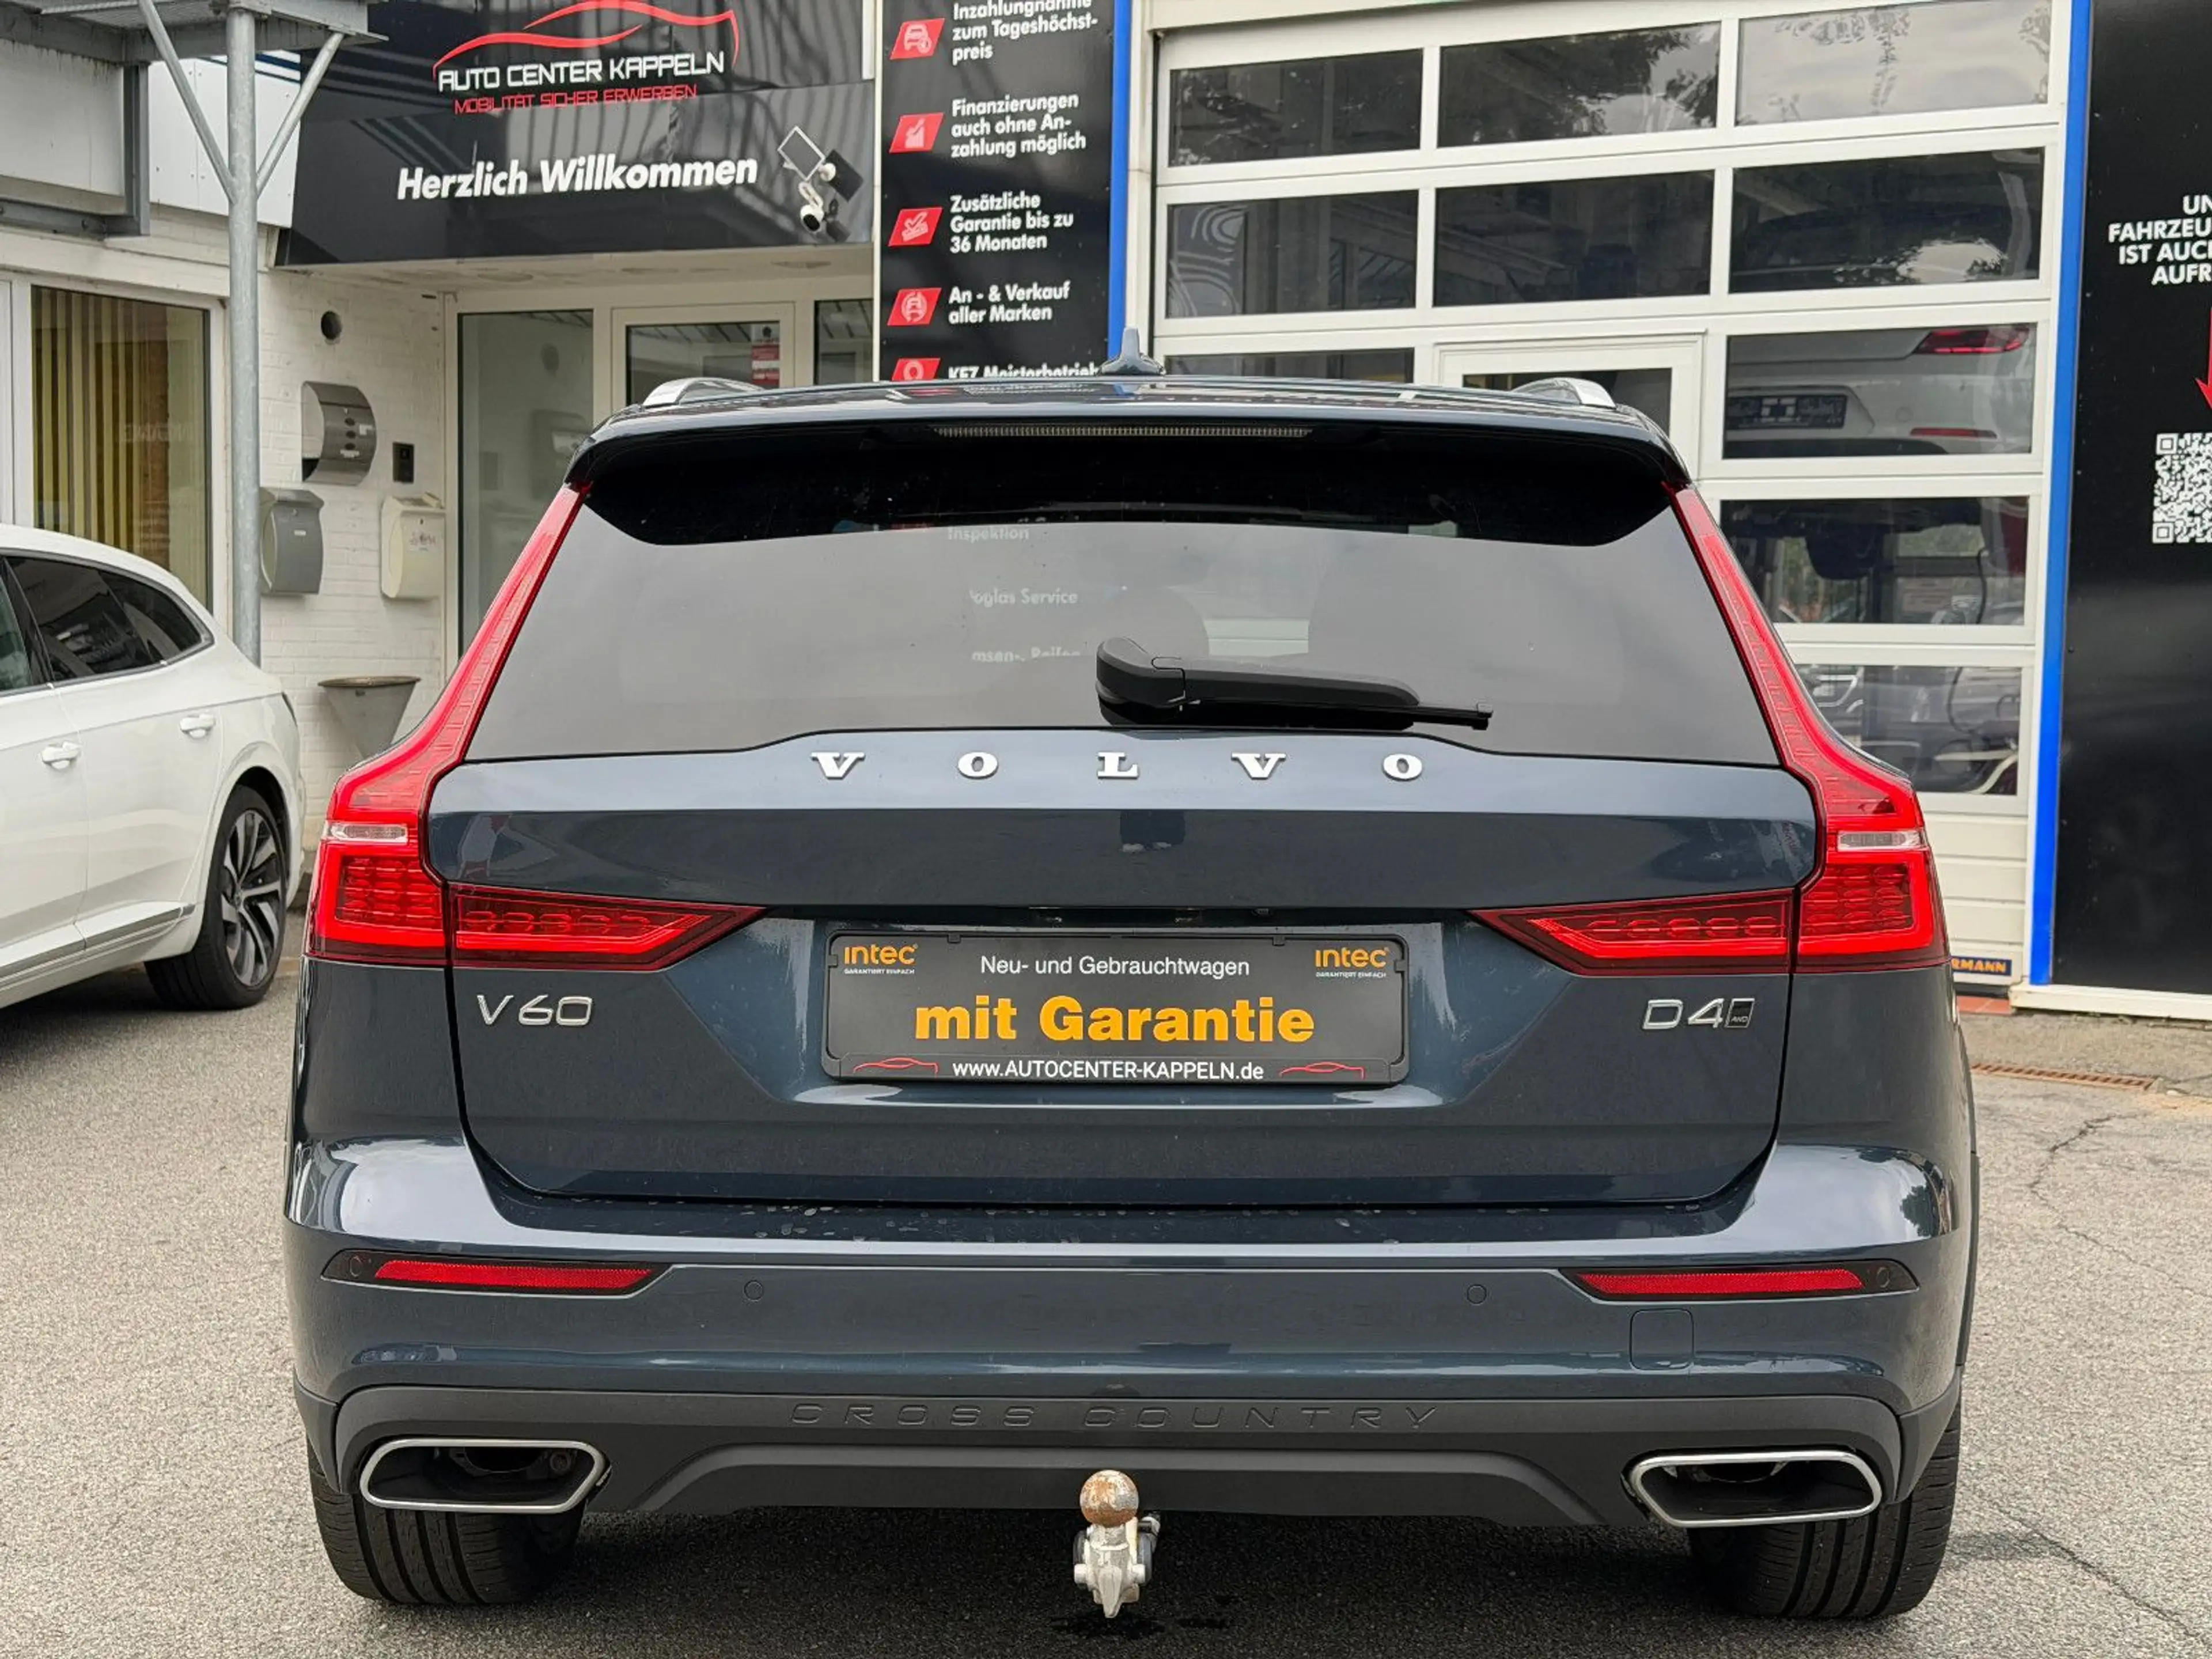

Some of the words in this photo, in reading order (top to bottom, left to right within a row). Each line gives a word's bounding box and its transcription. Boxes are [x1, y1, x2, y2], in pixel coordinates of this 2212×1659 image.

[952, 25, 987, 41] zum
[991, 12, 1098, 39] Tageshöchst-
[952, 40, 993, 66] preis
[438, 67, 499, 92] AUTO
[507, 62, 602, 88] CENTER
[609, 51, 725, 80] KAPPELN
[540, 89, 599, 108] SICHER
[603, 83, 698, 105] ERWERBEN
[952, 94, 1079, 116] Finanzierungen
[951, 116, 991, 137] auch
[995, 115, 1037, 134] ohne
[1040, 113, 1072, 131] An-
[951, 137, 1016, 158] zahlung
[1020, 130, 1086, 156] möglich
[397, 159, 528, 200] Herzlich
[540, 153, 758, 193] Willkommen
[950, 190, 1041, 213] Zusätzliche
[950, 212, 1022, 233] Garantie
[1025, 210, 1050, 229] bis
[1053, 213, 1074, 228] zu
[2108, 217, 2212, 243] FAHRZEU
[950, 235, 972, 253] 36
[975, 233, 1048, 252] Monaten
[2119, 243, 2153, 264] IST
[2151, 263, 2212, 286] AUFR
[948, 286, 972, 304] An
[988, 285, 1002, 302] &
[1005, 279, 1071, 301] Verkauf
[948, 305, 987, 324] aller
[988, 302, 1052, 323] Marken
[1020, 587, 1078, 605] Service
[812, 751, 1423, 781] VOLVO
[844, 944, 915, 965] intec
[1315, 946, 1387, 968] intec
[980, 955, 1029, 974] Neu-
[1035, 956, 1072, 974] und
[1079, 955, 1250, 979] Gebrauchtwagen
[476, 995, 593, 1026] V60
[914, 994, 1017, 1040] mit
[1039, 995, 1315, 1042] Garantie
[1643, 998, 1725, 1030] D4
[953, 1060, 1264, 1081] www.AUTOCENTER-KAPPELN.de
[791, 1403, 1037, 1427] CROSS
[1084, 1406, 1438, 1428] COUNTRY
